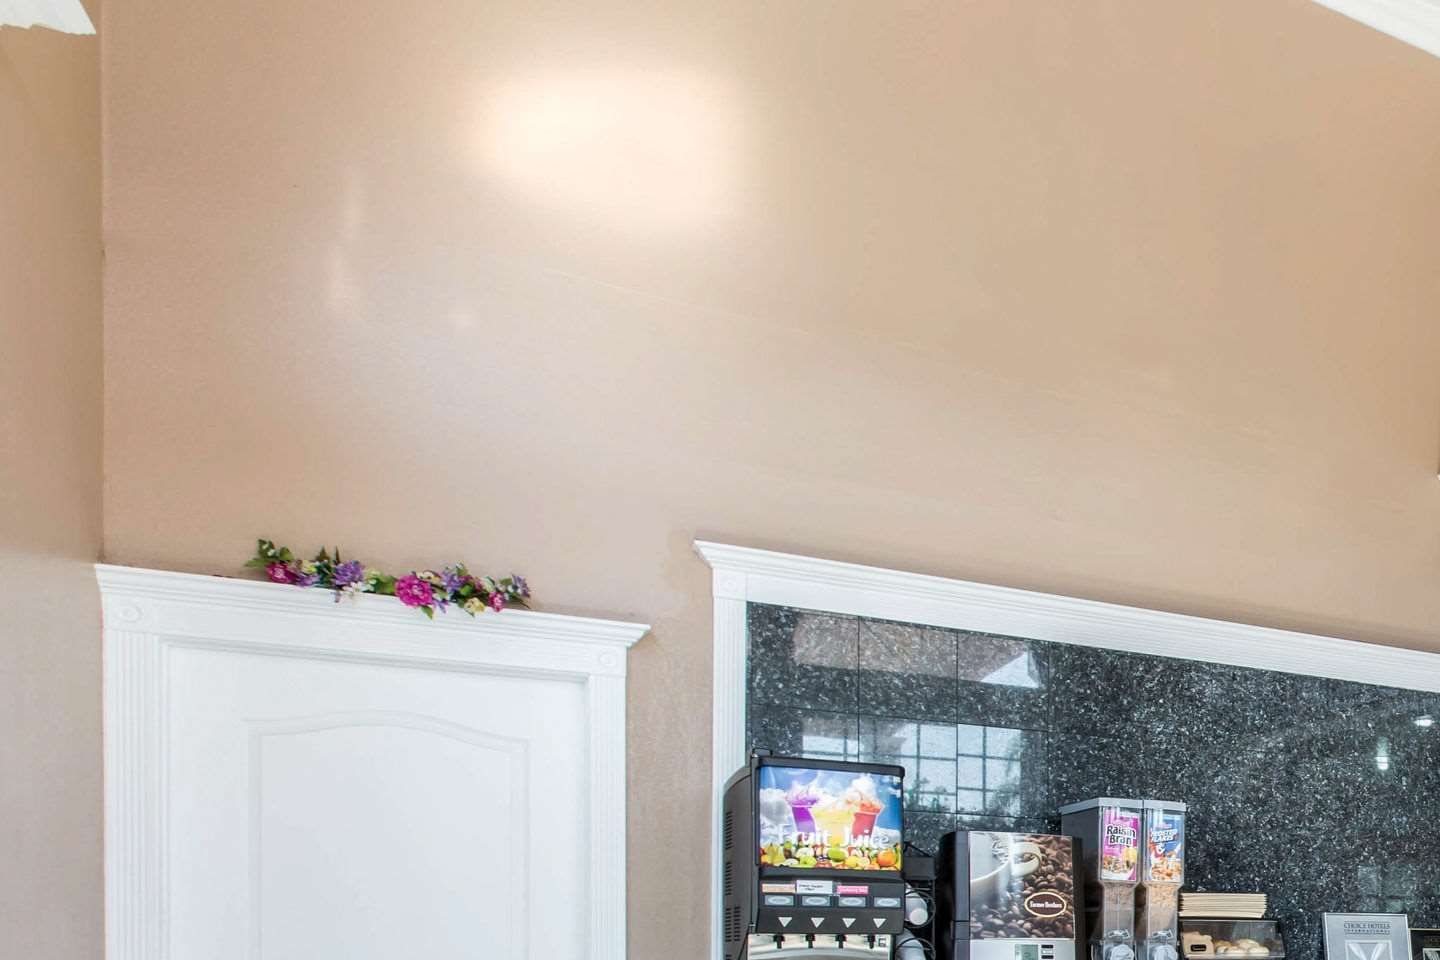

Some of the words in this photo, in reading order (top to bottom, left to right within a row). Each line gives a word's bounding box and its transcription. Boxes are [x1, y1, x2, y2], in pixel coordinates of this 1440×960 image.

[778, 823, 830, 848] Fruit
[840, 827, 889, 849] Juice
[1106, 825, 1136, 838] Raisin
[1109, 834, 1132, 844] Bran
